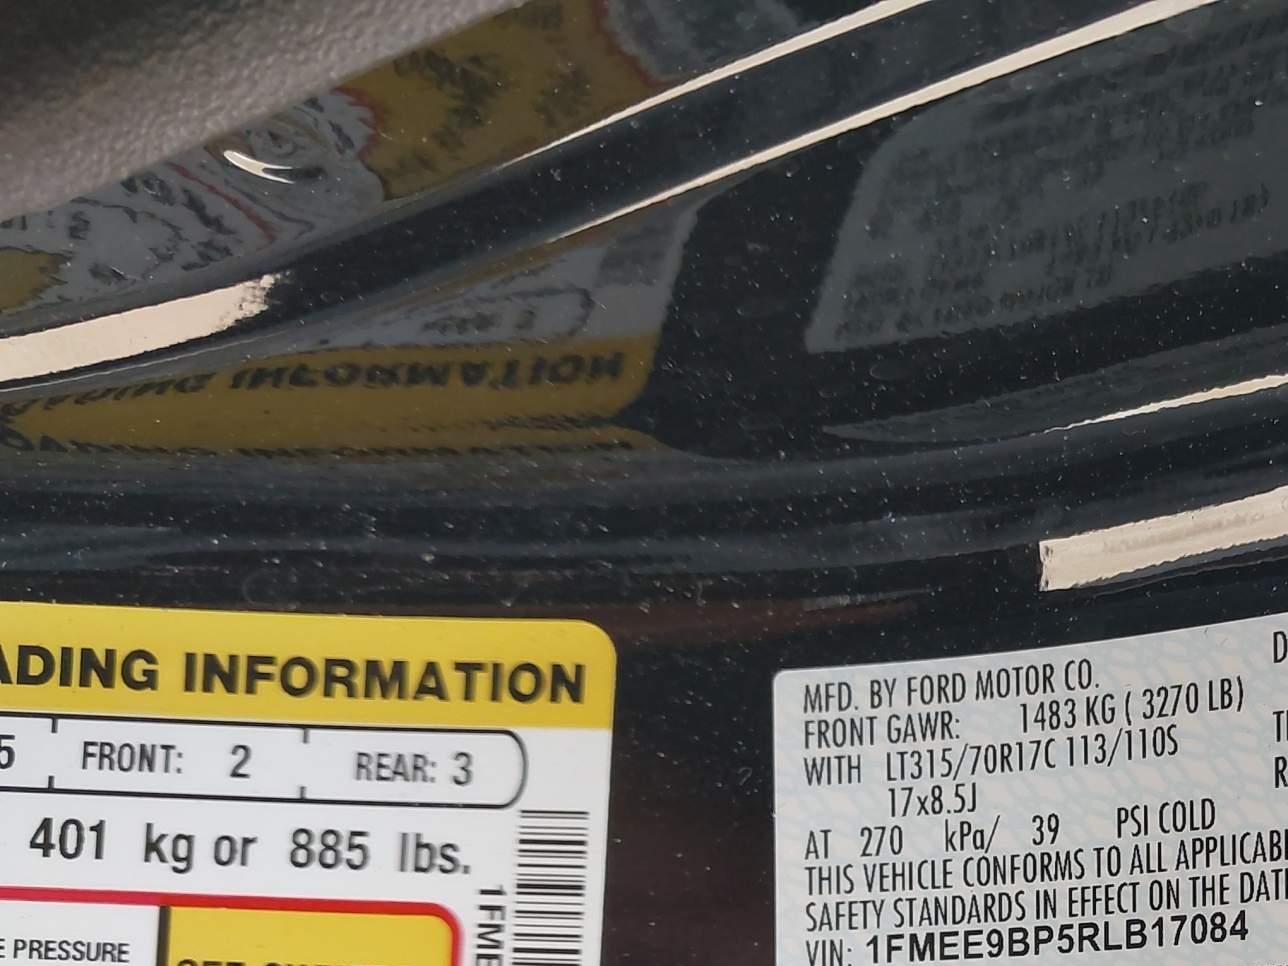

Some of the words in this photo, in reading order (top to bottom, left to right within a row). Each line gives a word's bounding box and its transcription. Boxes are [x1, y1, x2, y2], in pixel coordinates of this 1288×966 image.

[183, 651, 586, 704] INFORMATION
[803, 681, 859, 714] MFD.
[869, 677, 897, 710] BY
[906, 672, 967, 707] FORD
[975, 662, 1056, 701] MOTOR
[1064, 657, 1100, 692] CO.
[804, 715, 878, 750] FRONT
[886, 709, 960, 745] GAWR:
[1019, 697, 1077, 734] 1483
[1085, 692, 1116, 727] KG
[1142, 682, 1199, 720] 3270
[1208, 674, 1244, 713] LB)
[81, 740, 183, 774] FRONT:
[229, 744, 251, 779] 2
[355, 751, 436, 783] REAR:
[452, 751, 472, 787] 3
[803, 754, 862, 787] WITH
[886, 734, 1057, 782] LT315/70R17C
[1066, 723, 1179, 768] 113/110S
[887, 781, 977, 818] 17x8.5J
[29, 817, 106, 860] 401
[143, 822, 195, 875] kg
[213, 834, 258, 867] or
[289, 827, 370, 871] 885
[399, 832, 470, 875] lbs.
[804, 828, 832, 861] AT
[859, 824, 904, 858] 270
[944, 814, 1001, 855] kPa/
[1031, 812, 1060, 846] 39
[1116, 804, 1149, 839] PSI
[1158, 797, 1216, 835] COLD
[804, 863, 855, 897] THIS
[862, 858, 954, 893] VEHICLE
[962, 847, 1086, 888] CONFORMS
[1092, 844, 1122, 879] TO
[1128, 841, 1169, 876] ALL
[805, 898, 886, 933] SAFETY
[893, 889, 1026, 929] STANDARDS
[1035, 888, 1057, 921] IN
[1068, 881, 1141, 918] EFFECT
[1148, 877, 1180, 912] ON
[1188, 873, 1231, 908] THE
[12, 938, 130, 964] PRESSURE
[865, 909, 1249, 964] 1FMEE9BP5RLB17084
